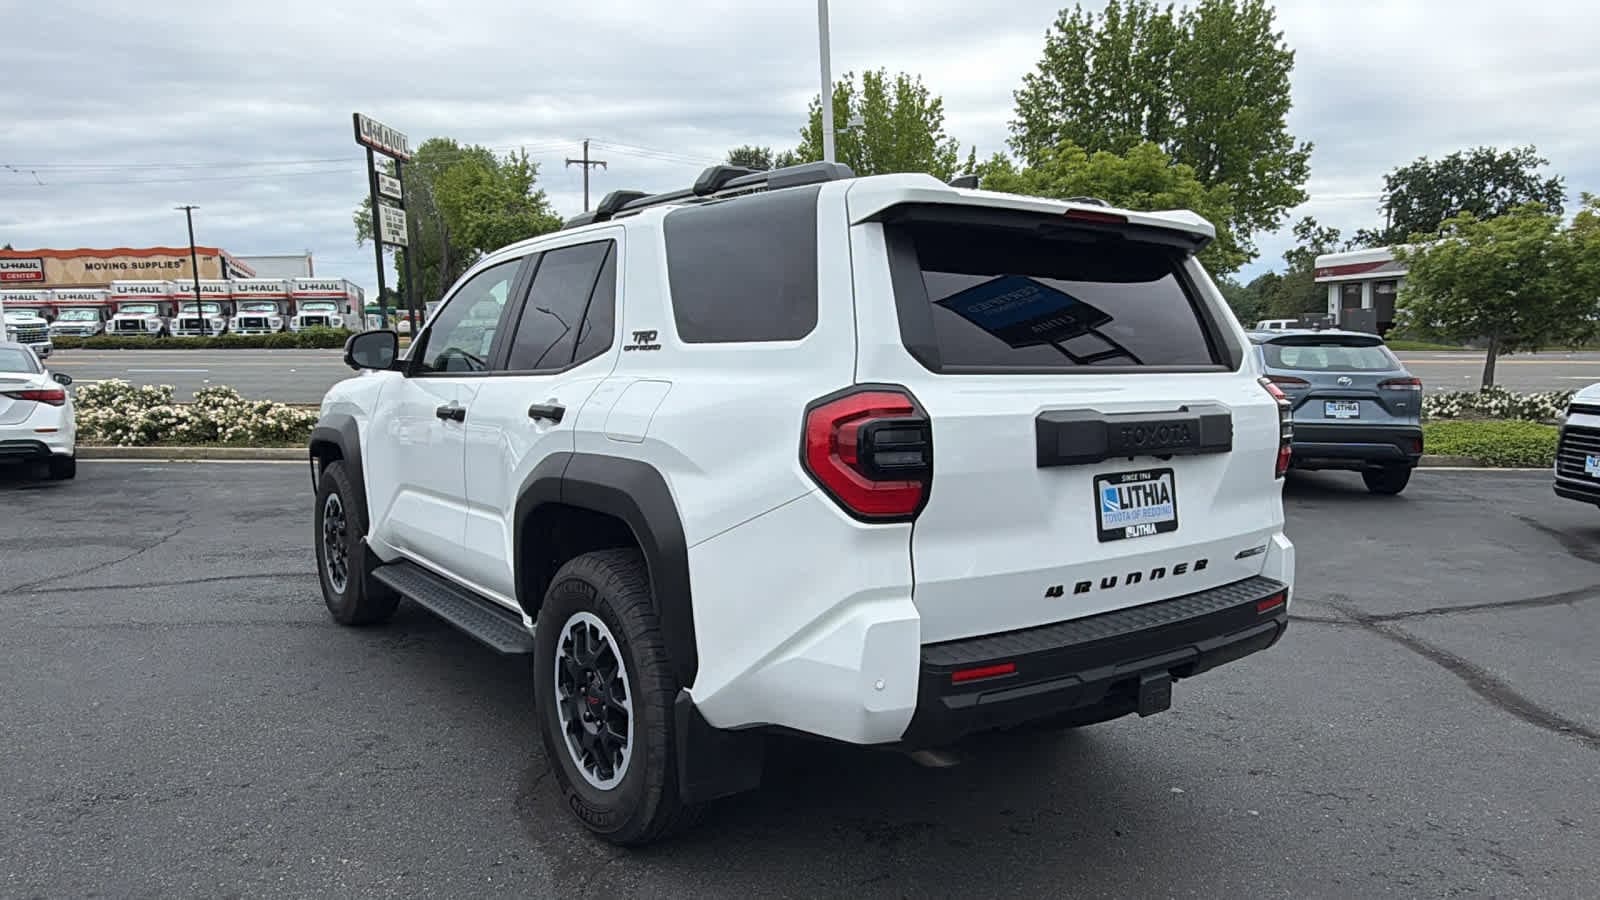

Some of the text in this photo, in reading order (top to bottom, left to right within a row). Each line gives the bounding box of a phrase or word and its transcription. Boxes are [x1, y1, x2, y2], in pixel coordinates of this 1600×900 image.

[85, 261, 180, 271] MOVING SUPPLIES
[117, 285, 162, 294] U-HAUL
[238, 284, 281, 292] U-HAUL
[298, 283, 340, 291] U-HAUL
[632, 331, 657, 344] TRD
[1121, 424, 1192, 446] TOYOTA
[1121, 474, 1138, 482] SINCE
[1117, 482, 1170, 510] LITHIA
[1103, 505, 1172, 522] TOYOTA OF REDDING
[1134, 523, 1157, 537] LITHIA
[1045, 558, 1209, 598] 4RUNNER
